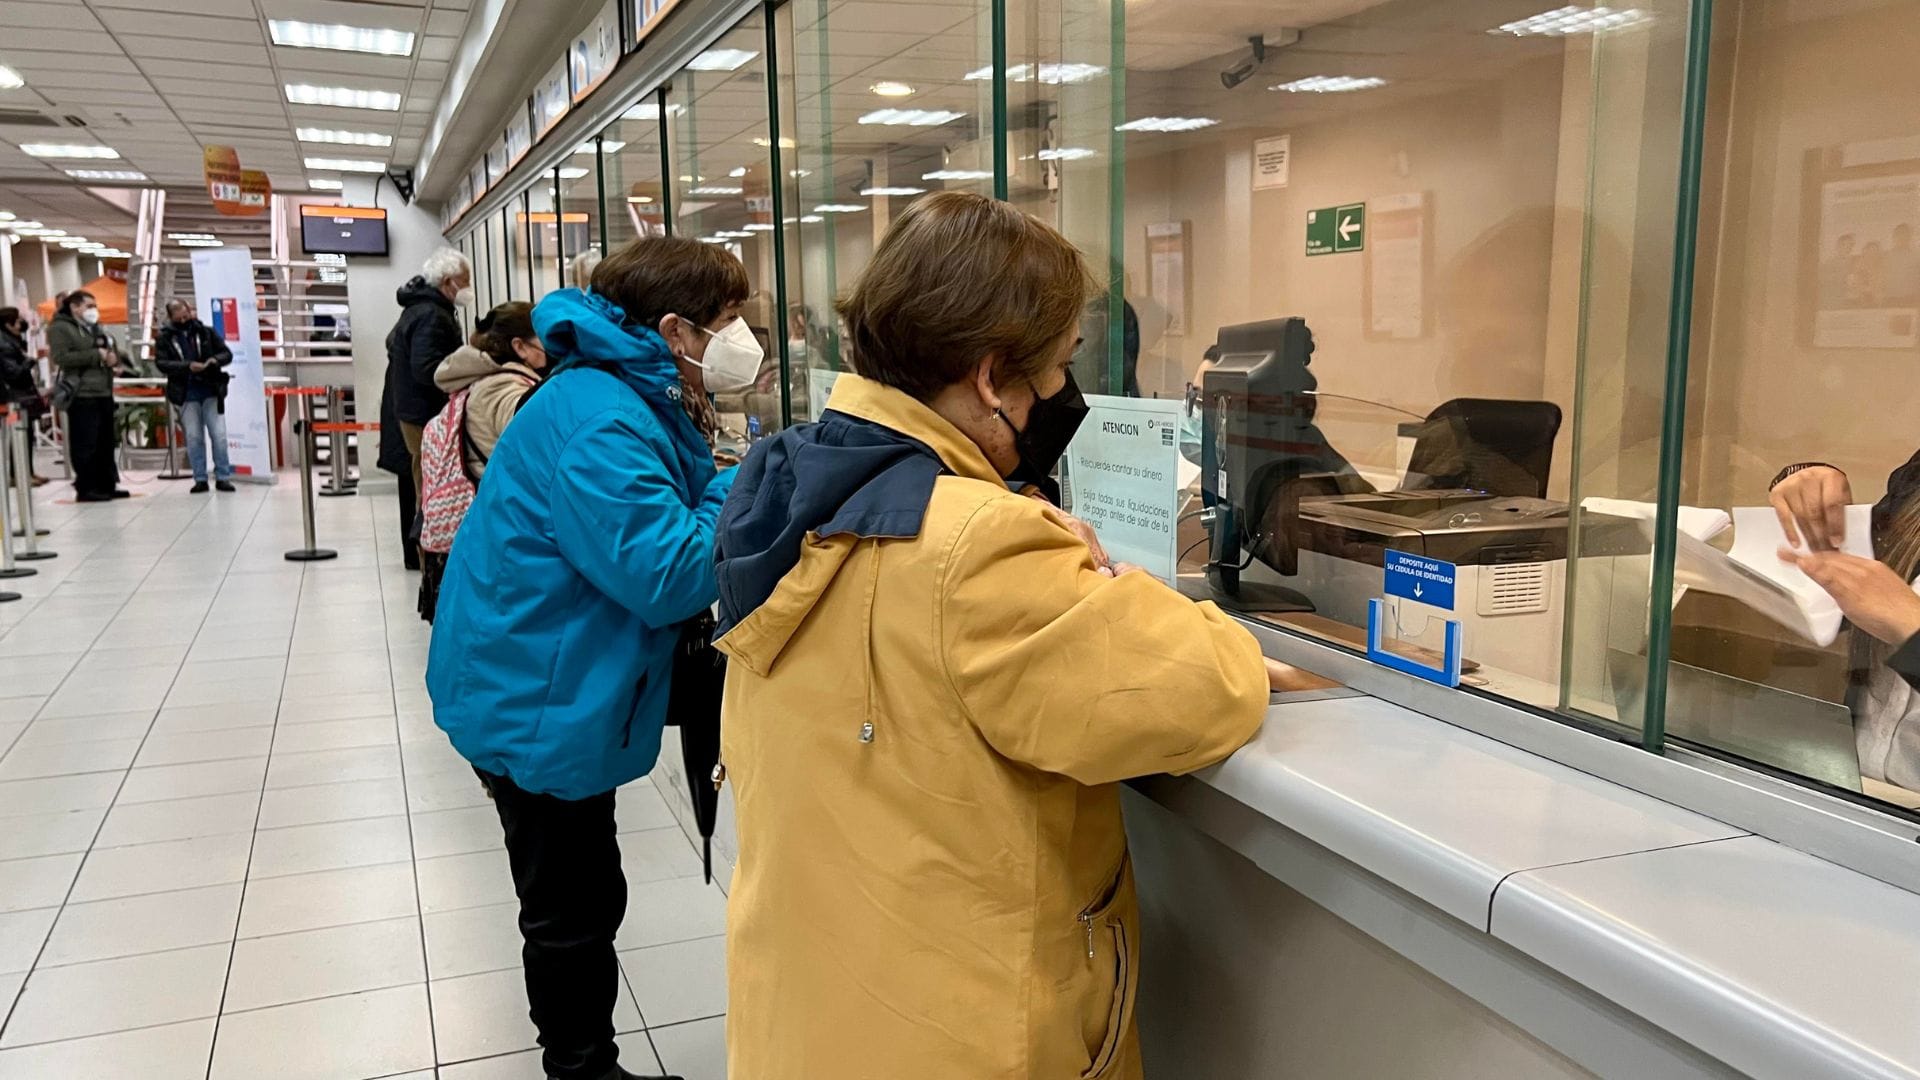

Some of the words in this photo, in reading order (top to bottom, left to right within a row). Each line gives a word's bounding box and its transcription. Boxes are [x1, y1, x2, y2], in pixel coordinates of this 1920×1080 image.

[1102, 421, 1139, 437] ATENCION
[1080, 456, 1111, 472] Recuerde
[1111, 464, 1133, 475] contar
[1133, 467, 1141, 477] su
[1141, 467, 1163, 481] dinero
[1098, 492, 1114, 506] todas
[1116, 497, 1125, 508] sus
[1127, 498, 1169, 519] liquidaciones
[1082, 503, 1091, 513] de
[1109, 510, 1126, 522] antes
[1126, 514, 1136, 525] de
[1137, 516, 1150, 528] salir
[1150, 519, 1161, 531] de
[1162, 521, 1169, 533] la
[1386, 562, 1395, 571] SU
[1415, 569, 1423, 578] DE
[1423, 571, 1454, 585] IDENTIDAD
[1399, 556, 1424, 569] DEPOSITE
